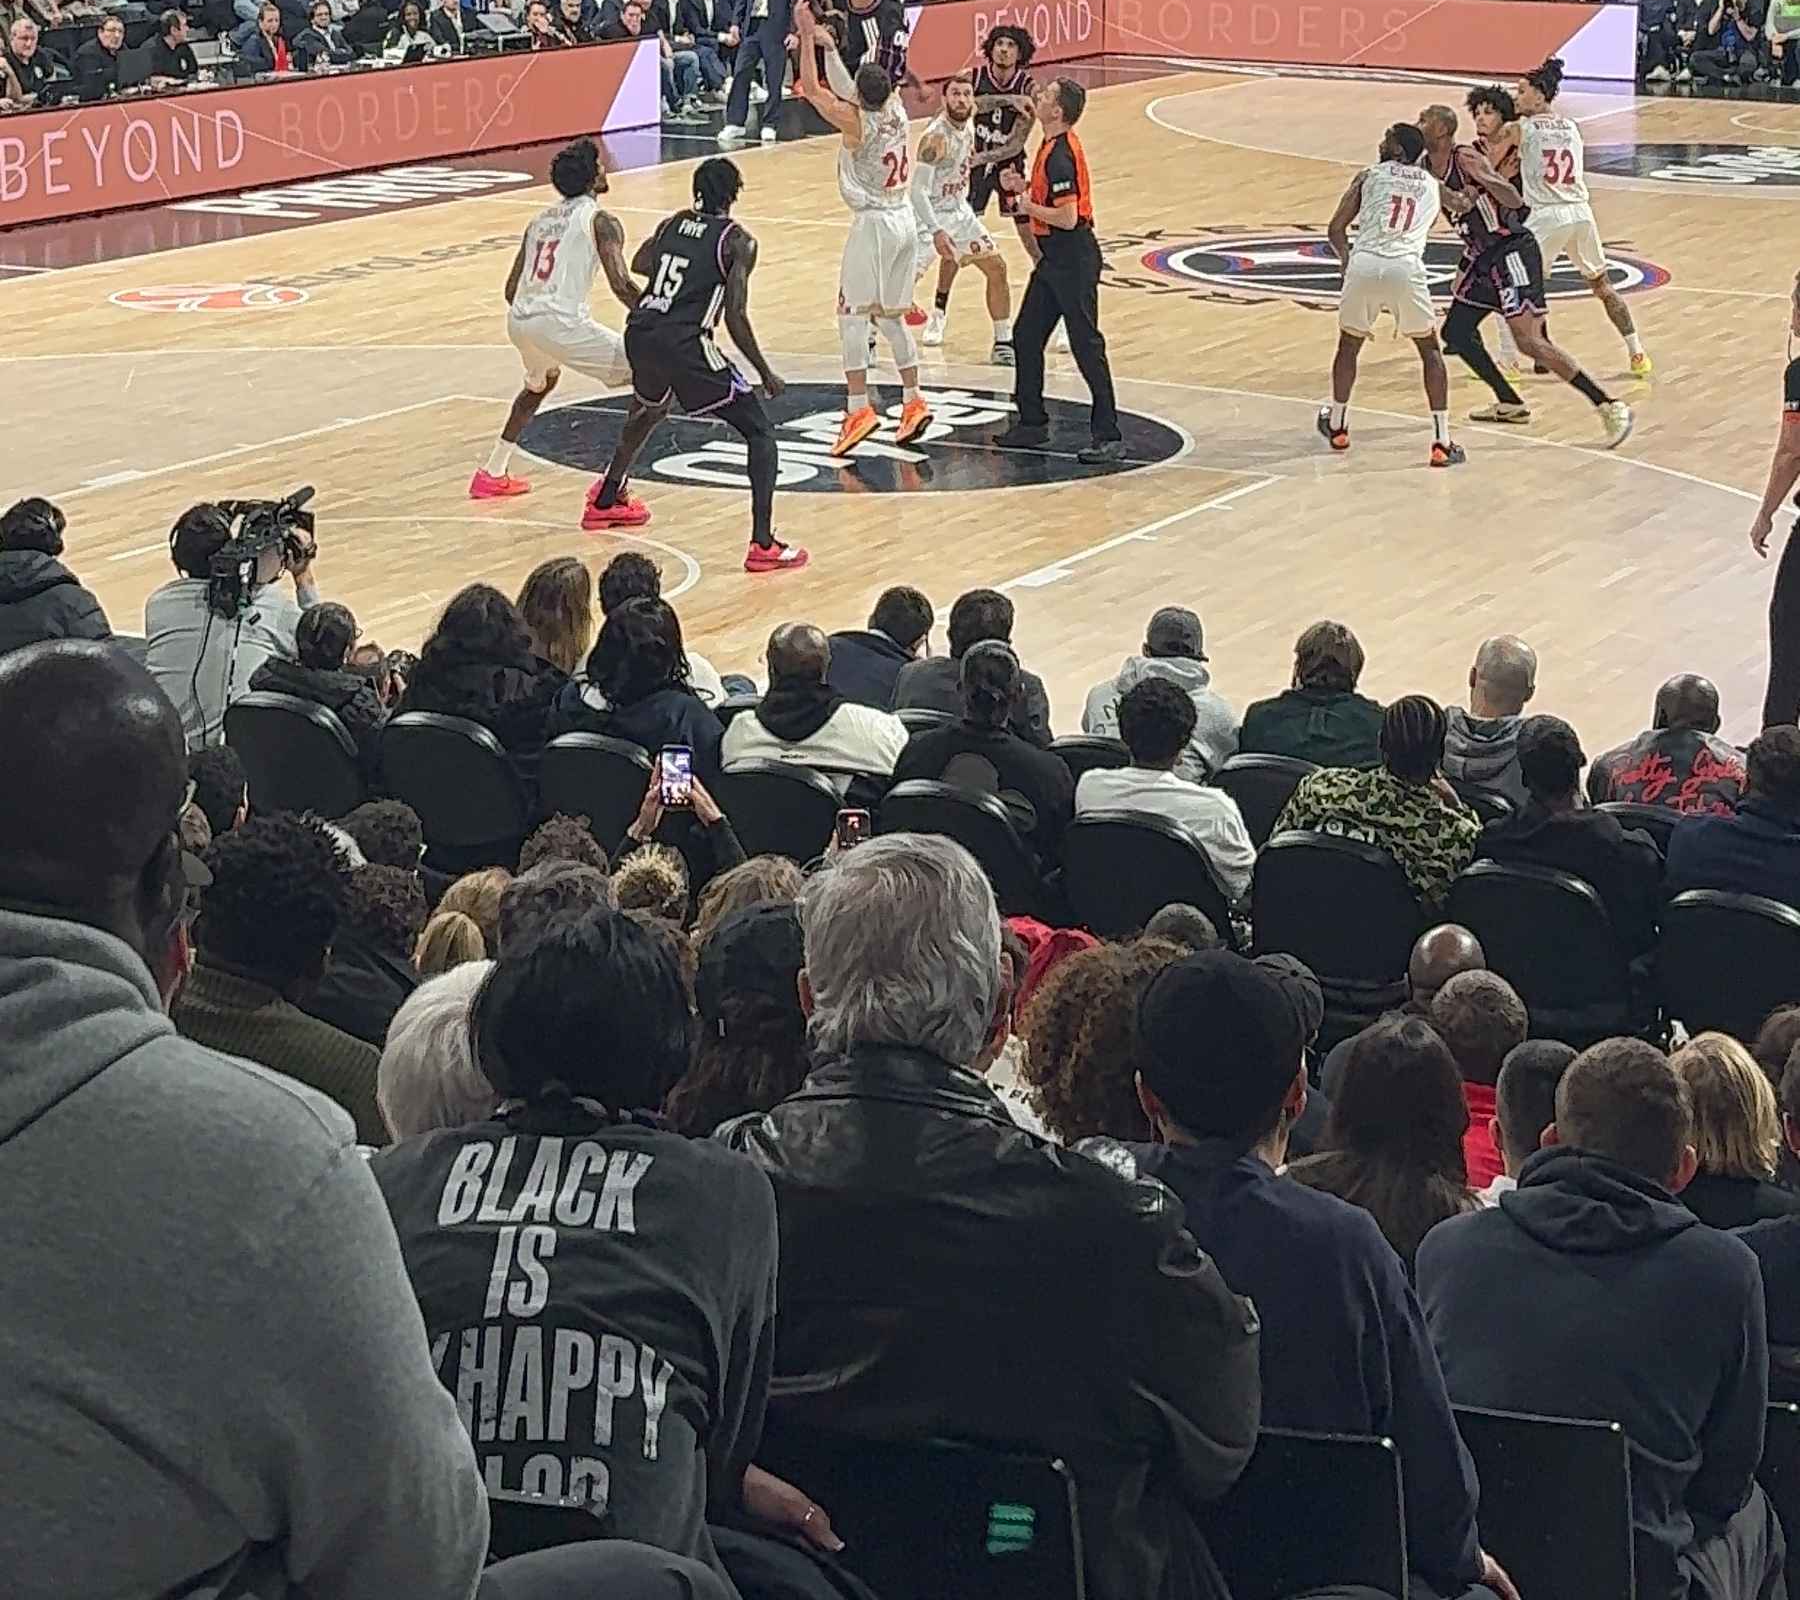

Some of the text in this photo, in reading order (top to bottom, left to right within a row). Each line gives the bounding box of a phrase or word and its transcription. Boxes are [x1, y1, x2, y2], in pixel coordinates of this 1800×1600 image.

[0, 72, 517, 201] BEYOND BORDERS
[991, 107, 1002, 124] 8
[1541, 148, 1576, 186] 32
[1388, 194, 1416, 232] 11
[530, 238, 561, 282] 13
[653, 252, 691, 298] 15
[437, 1135, 655, 1235] BLACK
[482, 1225, 557, 1320] IS
[456, 1325, 675, 1462] HAPPY
